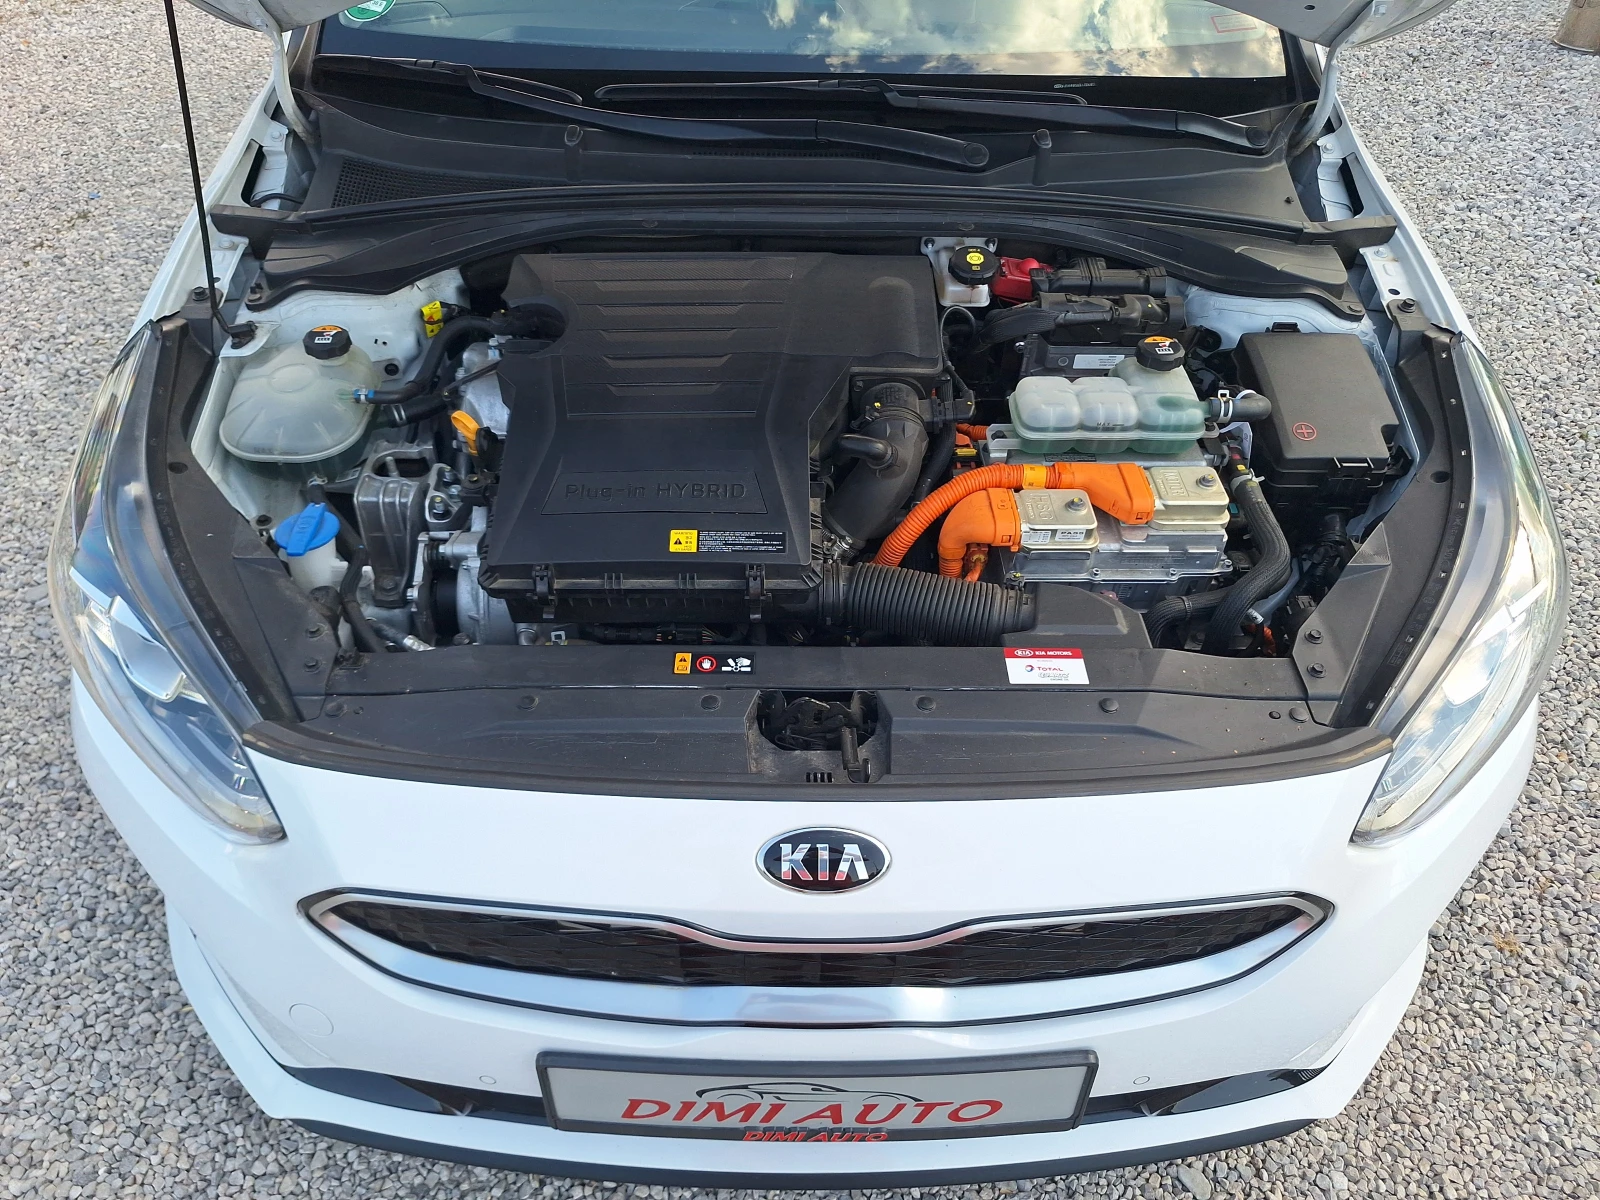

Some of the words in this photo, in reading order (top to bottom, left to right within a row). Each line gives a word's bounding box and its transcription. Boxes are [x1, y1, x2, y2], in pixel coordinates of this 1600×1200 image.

[565, 484, 646, 501] Plug-in
[656, 482, 748, 499] HYBRID
[779, 843, 870, 881] KIA
[621, 1098, 787, 1124] DIMI
[792, 1099, 1003, 1125] AUTO
[743, 1131, 806, 1142] DIMI
[807, 1132, 889, 1143] AUTO
